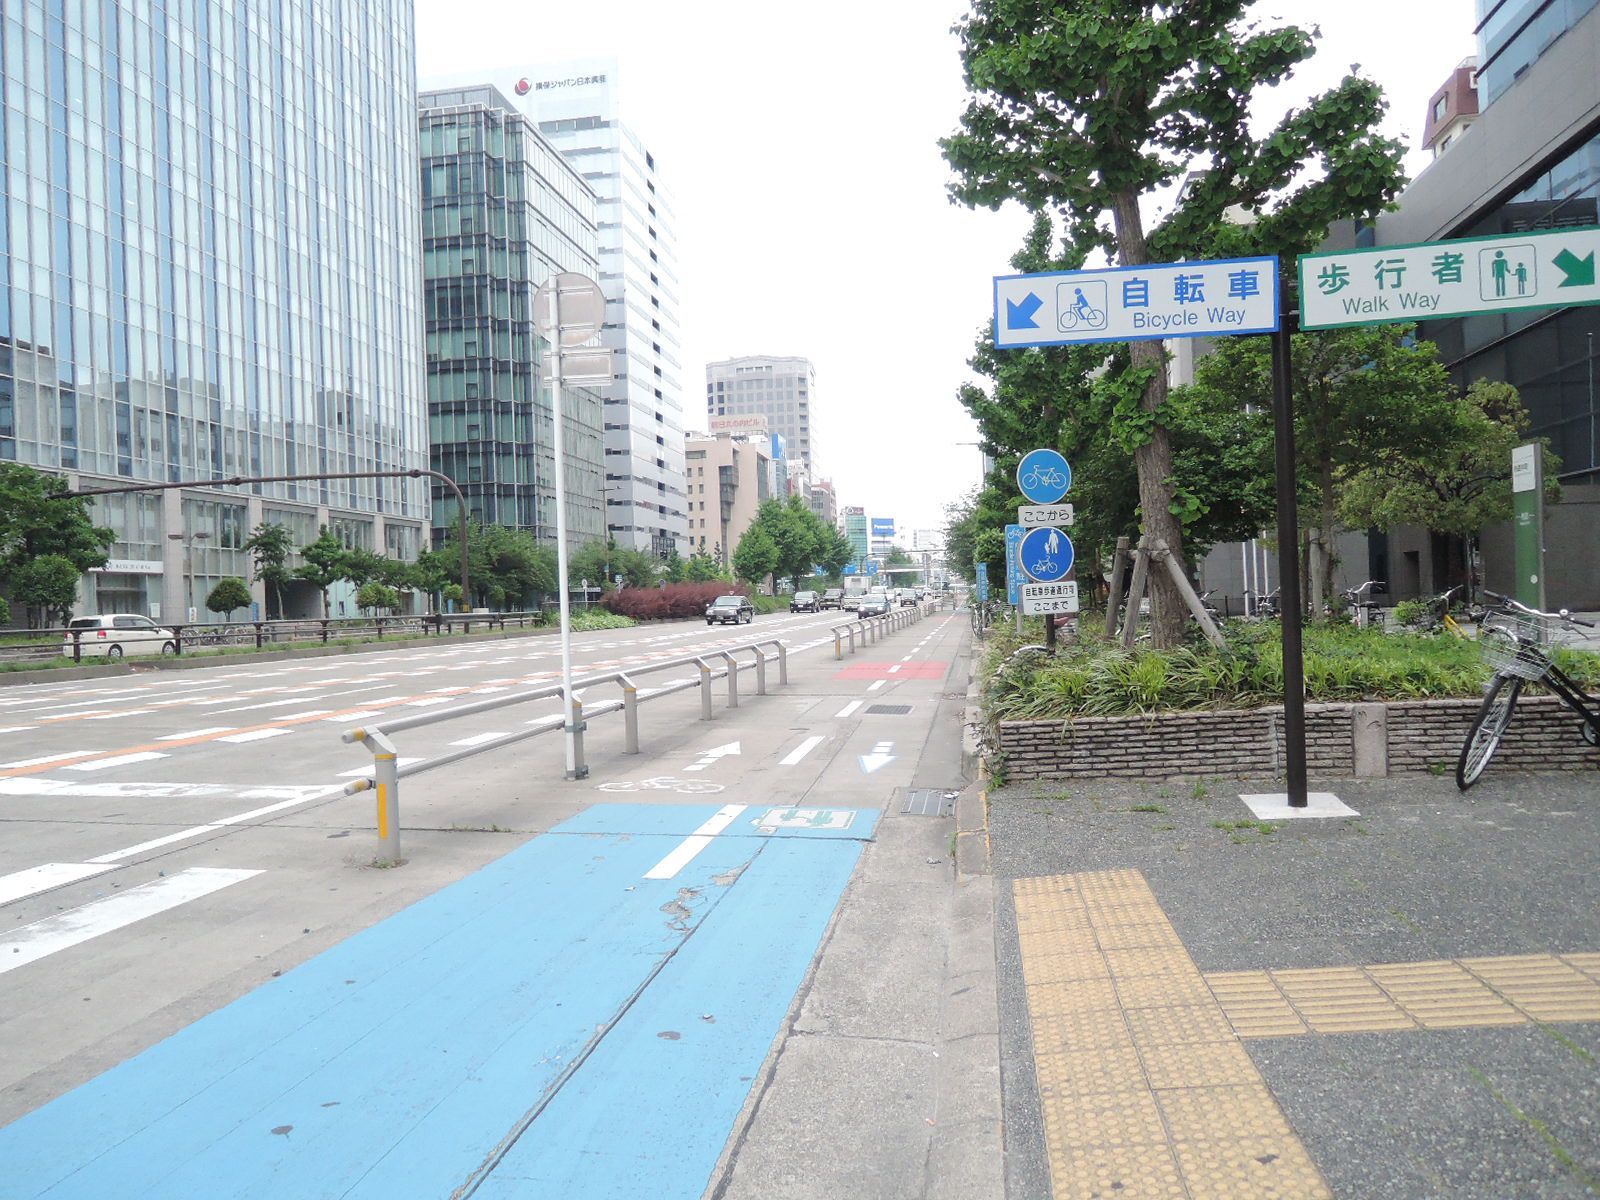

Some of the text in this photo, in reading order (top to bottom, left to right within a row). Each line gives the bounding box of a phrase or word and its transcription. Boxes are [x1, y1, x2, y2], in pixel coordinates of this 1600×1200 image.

[1317, 251, 1464, 296] 歩行者
[1122, 269, 1260, 309] 自転車
[1342, 292, 1441, 315] Walk Way
[1133, 306, 1246, 331] Bicycle Way
[1024, 509, 1070, 522] ここから
[1034, 600, 1069, 611] ここまで
